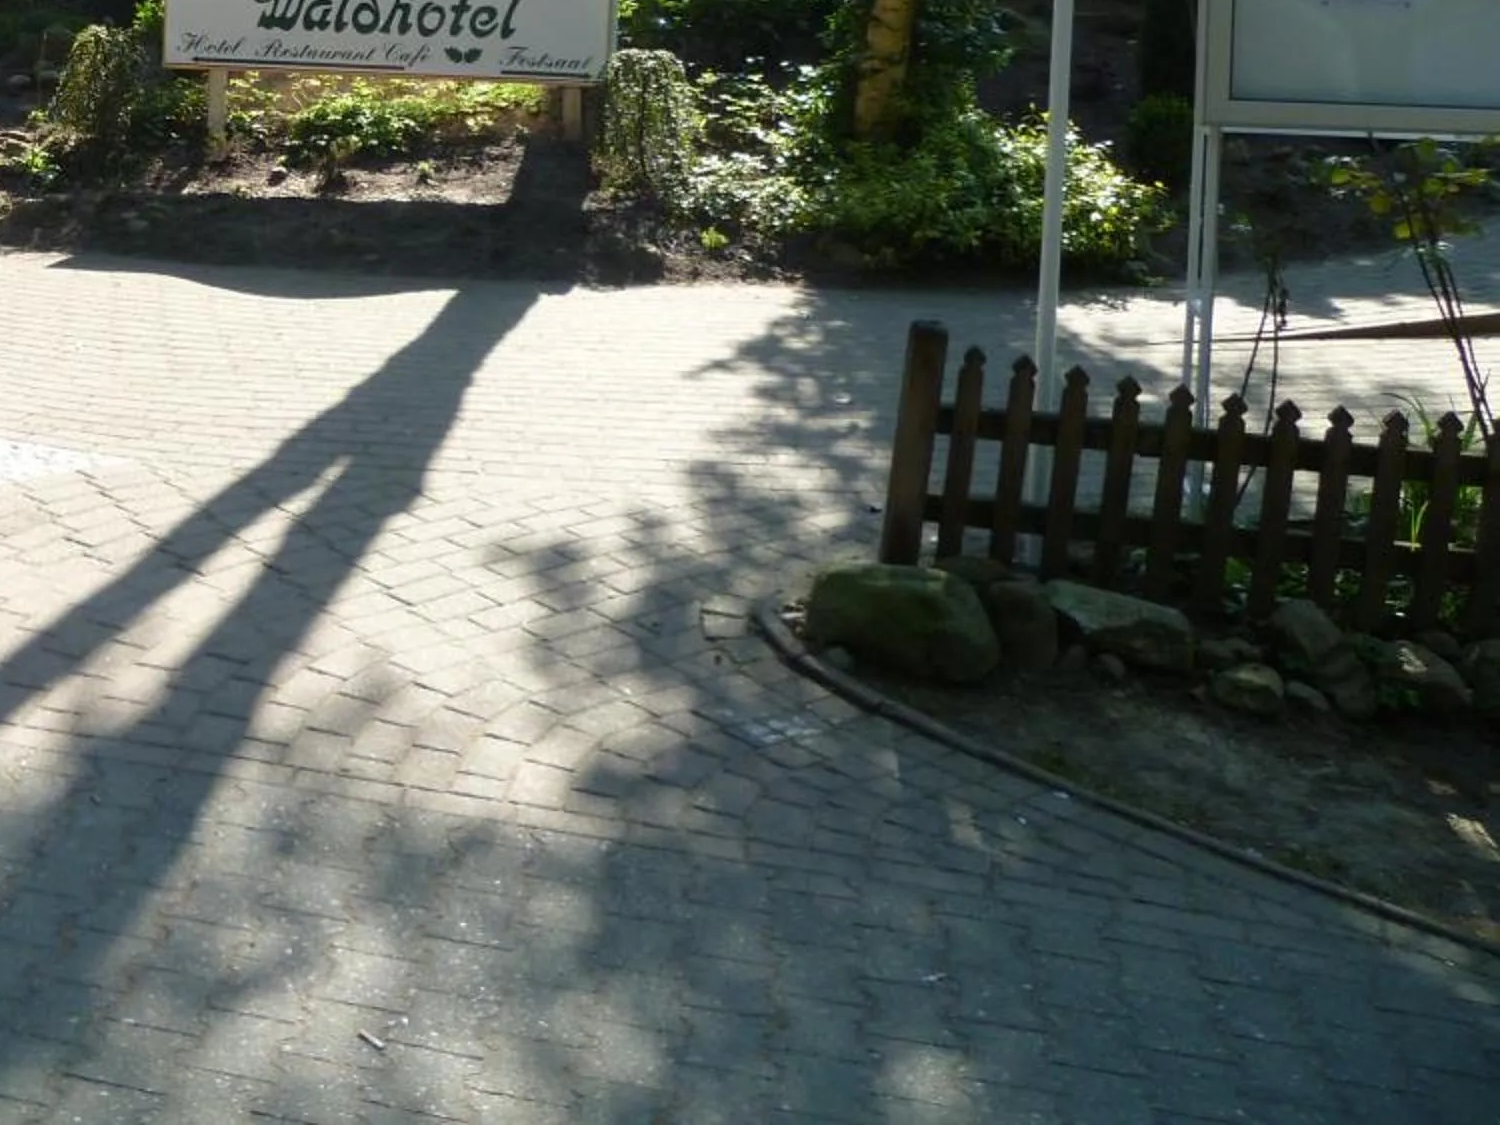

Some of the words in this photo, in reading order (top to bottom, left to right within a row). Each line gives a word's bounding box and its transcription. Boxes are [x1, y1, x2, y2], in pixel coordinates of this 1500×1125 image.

[177, 32, 245, 55] Hotel
[254, 39, 376, 62] Restaurant
[500, 46, 593, 69] Festsaal
